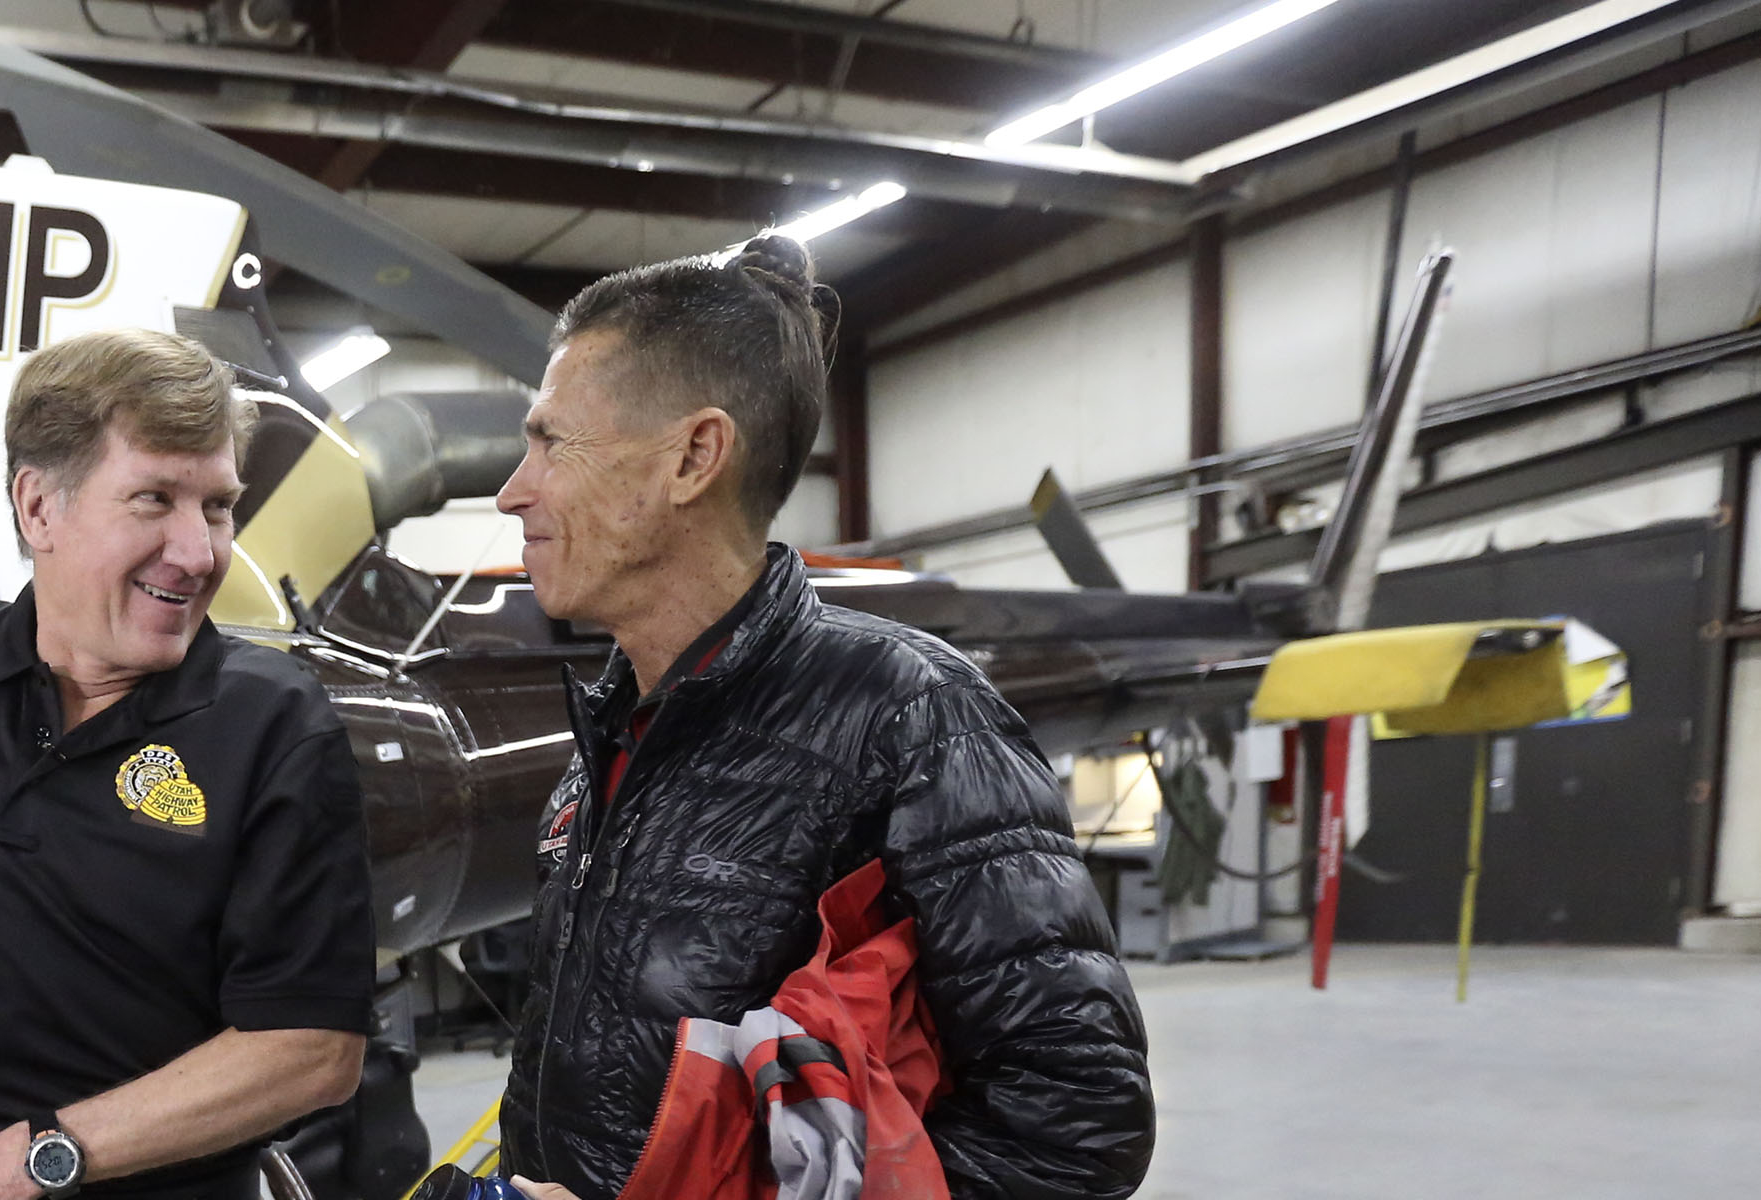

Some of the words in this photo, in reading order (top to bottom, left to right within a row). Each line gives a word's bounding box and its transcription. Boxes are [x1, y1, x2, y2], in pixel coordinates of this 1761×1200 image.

[146, 750, 173, 761] DPS
[169, 782, 193, 795] UTAH
[155, 789, 199, 807] HIGHWAY
[152, 799, 196, 817] PATROL
